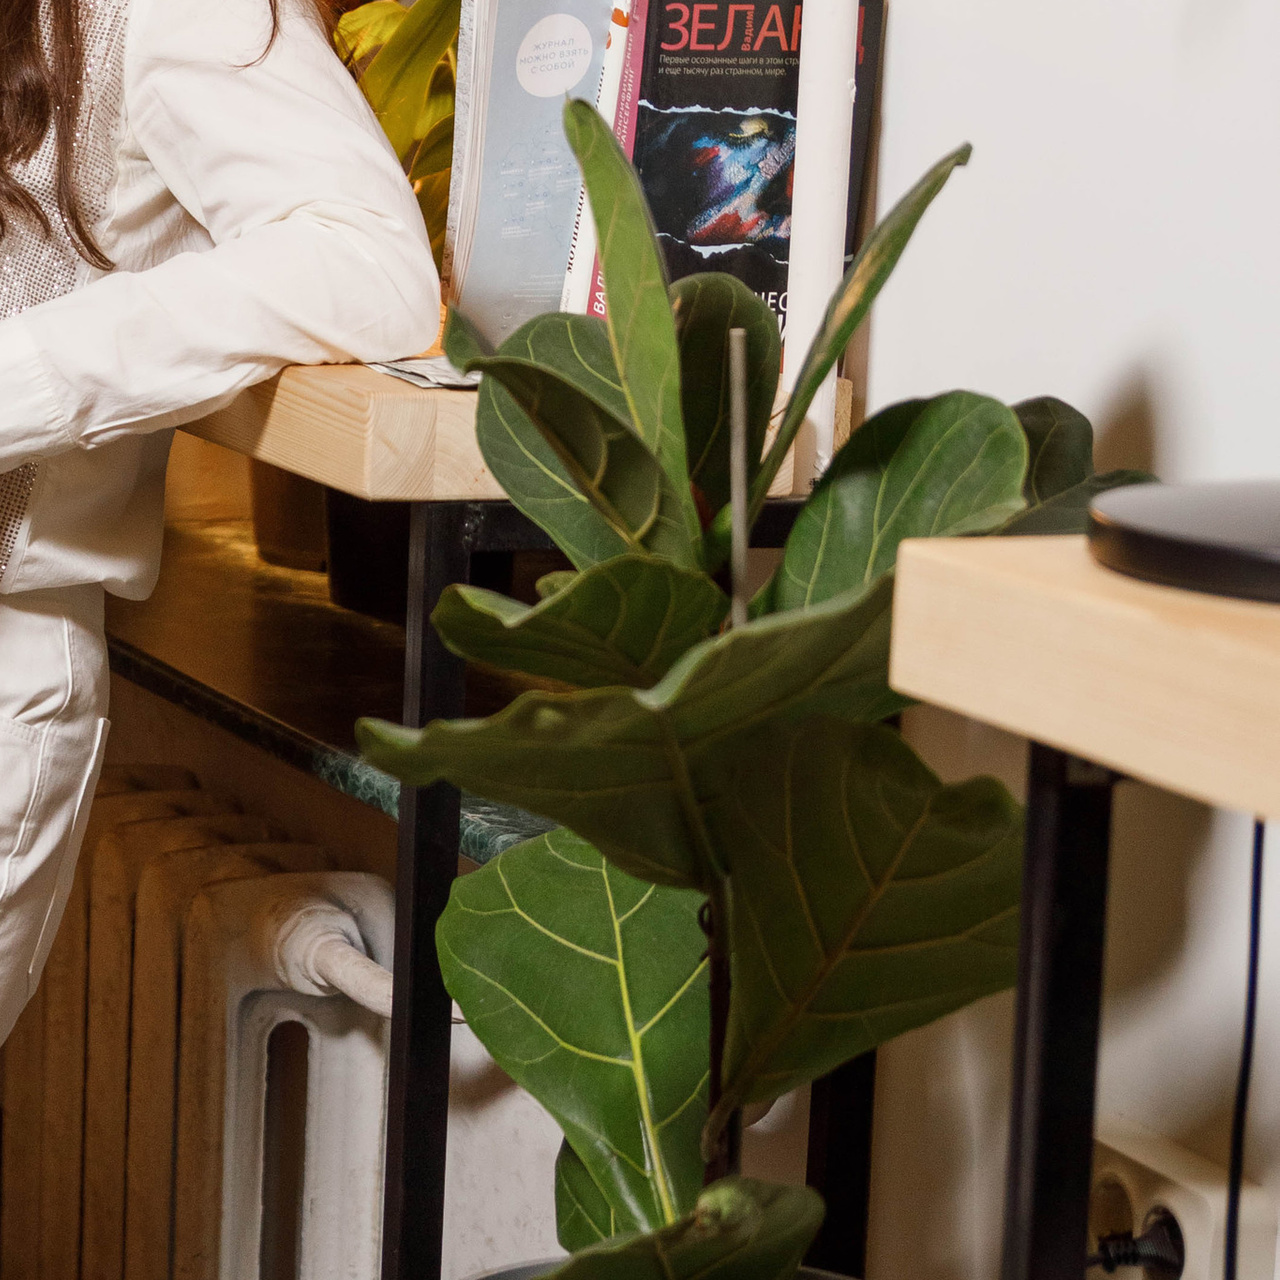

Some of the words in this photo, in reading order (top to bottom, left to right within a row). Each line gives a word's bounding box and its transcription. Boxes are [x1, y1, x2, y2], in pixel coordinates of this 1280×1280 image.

[741, 10, 755, 51] Вадим
[533, 38, 575, 51] ЖУРНАЛ
[519, 52, 556, 65] МОЖНО
[559, 48, 589, 59] ВЗЯТЬ
[659, 54, 690, 66] Первые
[691, 56, 738, 65] осознанные
[738, 57, 758, 65] шаги
[759, 57, 764, 65] в
[765, 57, 784, 65] этом
[784, 57, 800, 67] стр
[530, 66, 537, 75] С
[539, 59, 575, 73] СОБОЙ
[658, 66, 664, 74] и
[665, 66, 681, 76] еще
[683, 66, 710, 77] тысячу
[710, 66, 724, 76] раз
[621, 68, 635, 149] РАНСЕРФИНГ
